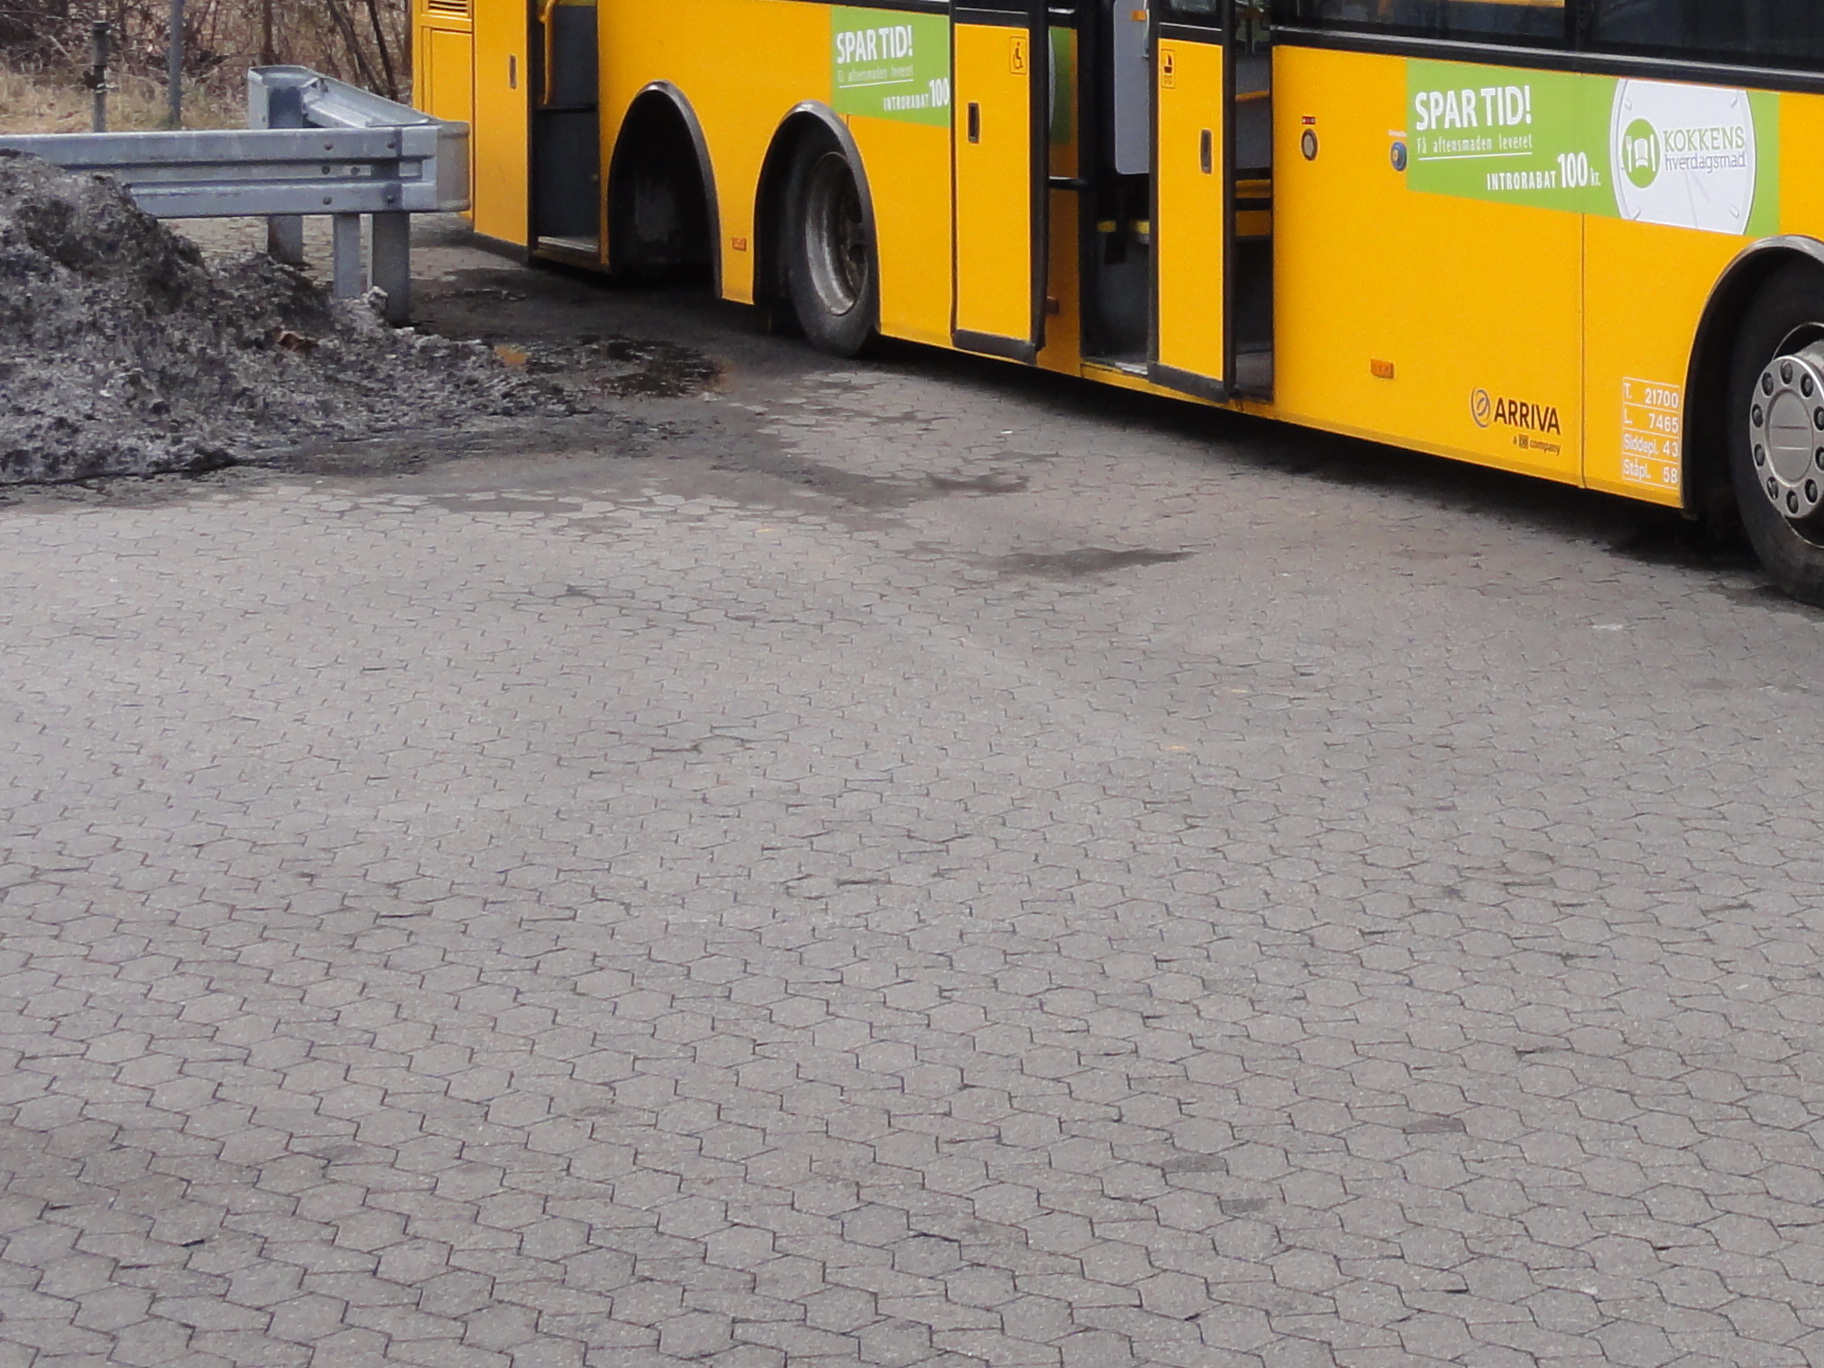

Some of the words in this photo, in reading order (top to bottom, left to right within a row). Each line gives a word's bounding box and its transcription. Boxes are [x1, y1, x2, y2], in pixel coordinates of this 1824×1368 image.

[836, 29, 878, 64] SPAR
[878, 25, 914, 60] TID!
[929, 78, 950, 107] 100
[1415, 88, 1478, 131] SPAR
[1480, 85, 1532, 126] TID!
[1417, 138, 1427, 154] Få
[1433, 135, 1492, 152] aftensmaden
[1499, 133, 1533, 150] leveret
[1663, 126, 1745, 152] KOKKENS
[1487, 170, 1556, 191] INTRORABAT
[1557, 152, 1588, 188] 100
[1664, 151, 1746, 174] hverdagsmad
[1645, 388, 1679, 408] 21700
[1494, 397, 1561, 435] ARRIVA
[1649, 413, 1678, 432] 7465
[1663, 441, 1679, 457] 43
[1663, 466, 1678, 483] 58
